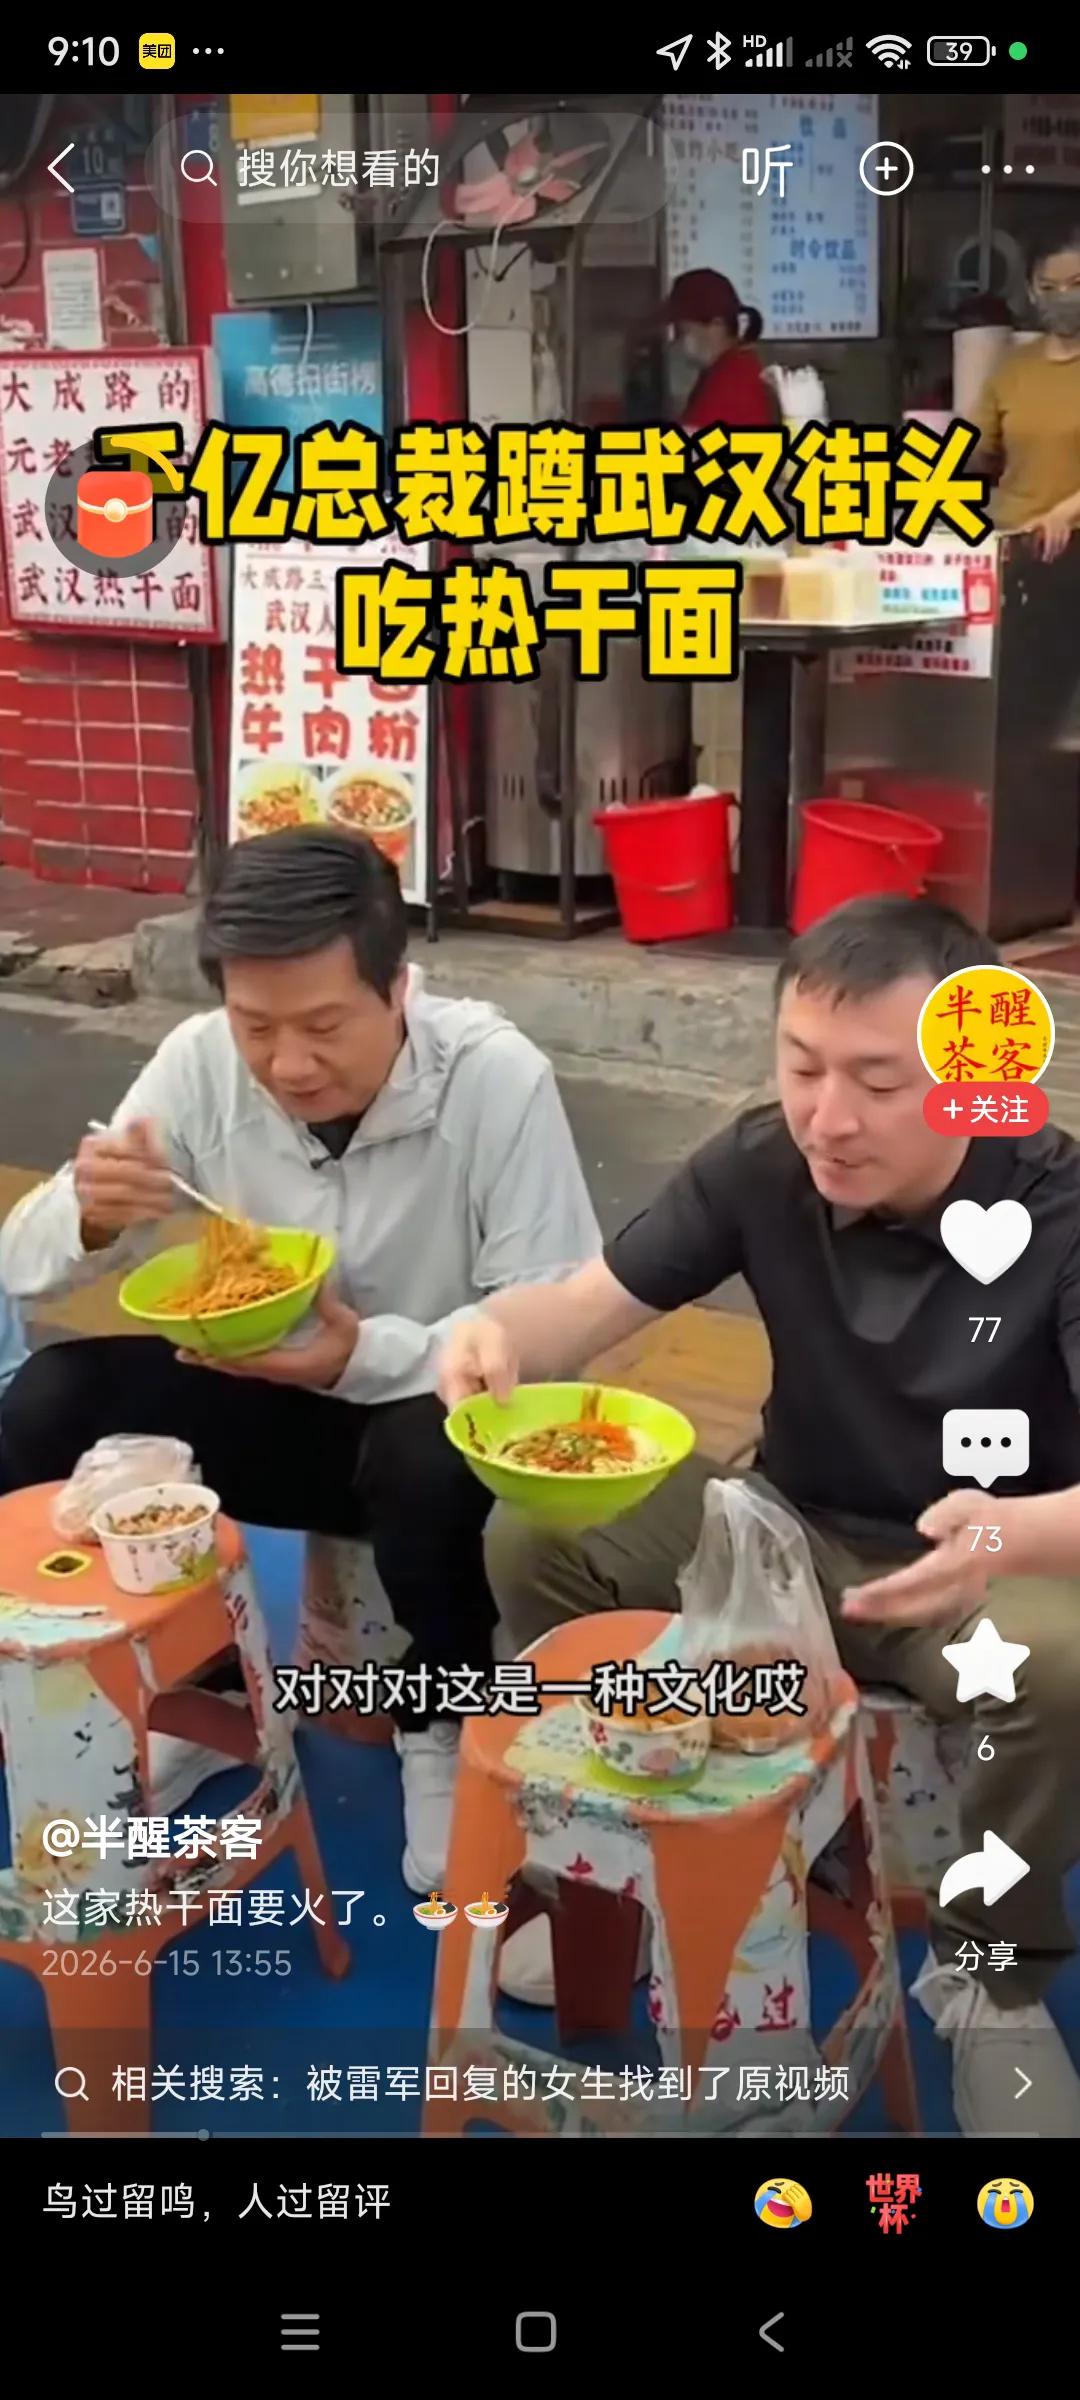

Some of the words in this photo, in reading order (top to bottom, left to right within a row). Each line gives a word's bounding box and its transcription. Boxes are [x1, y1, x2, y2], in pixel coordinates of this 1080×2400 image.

[2, 371, 191, 414] 大成路的
[18, 563, 201, 612] 武汉热干面
[241, 702, 420, 762] 牛肉粉
